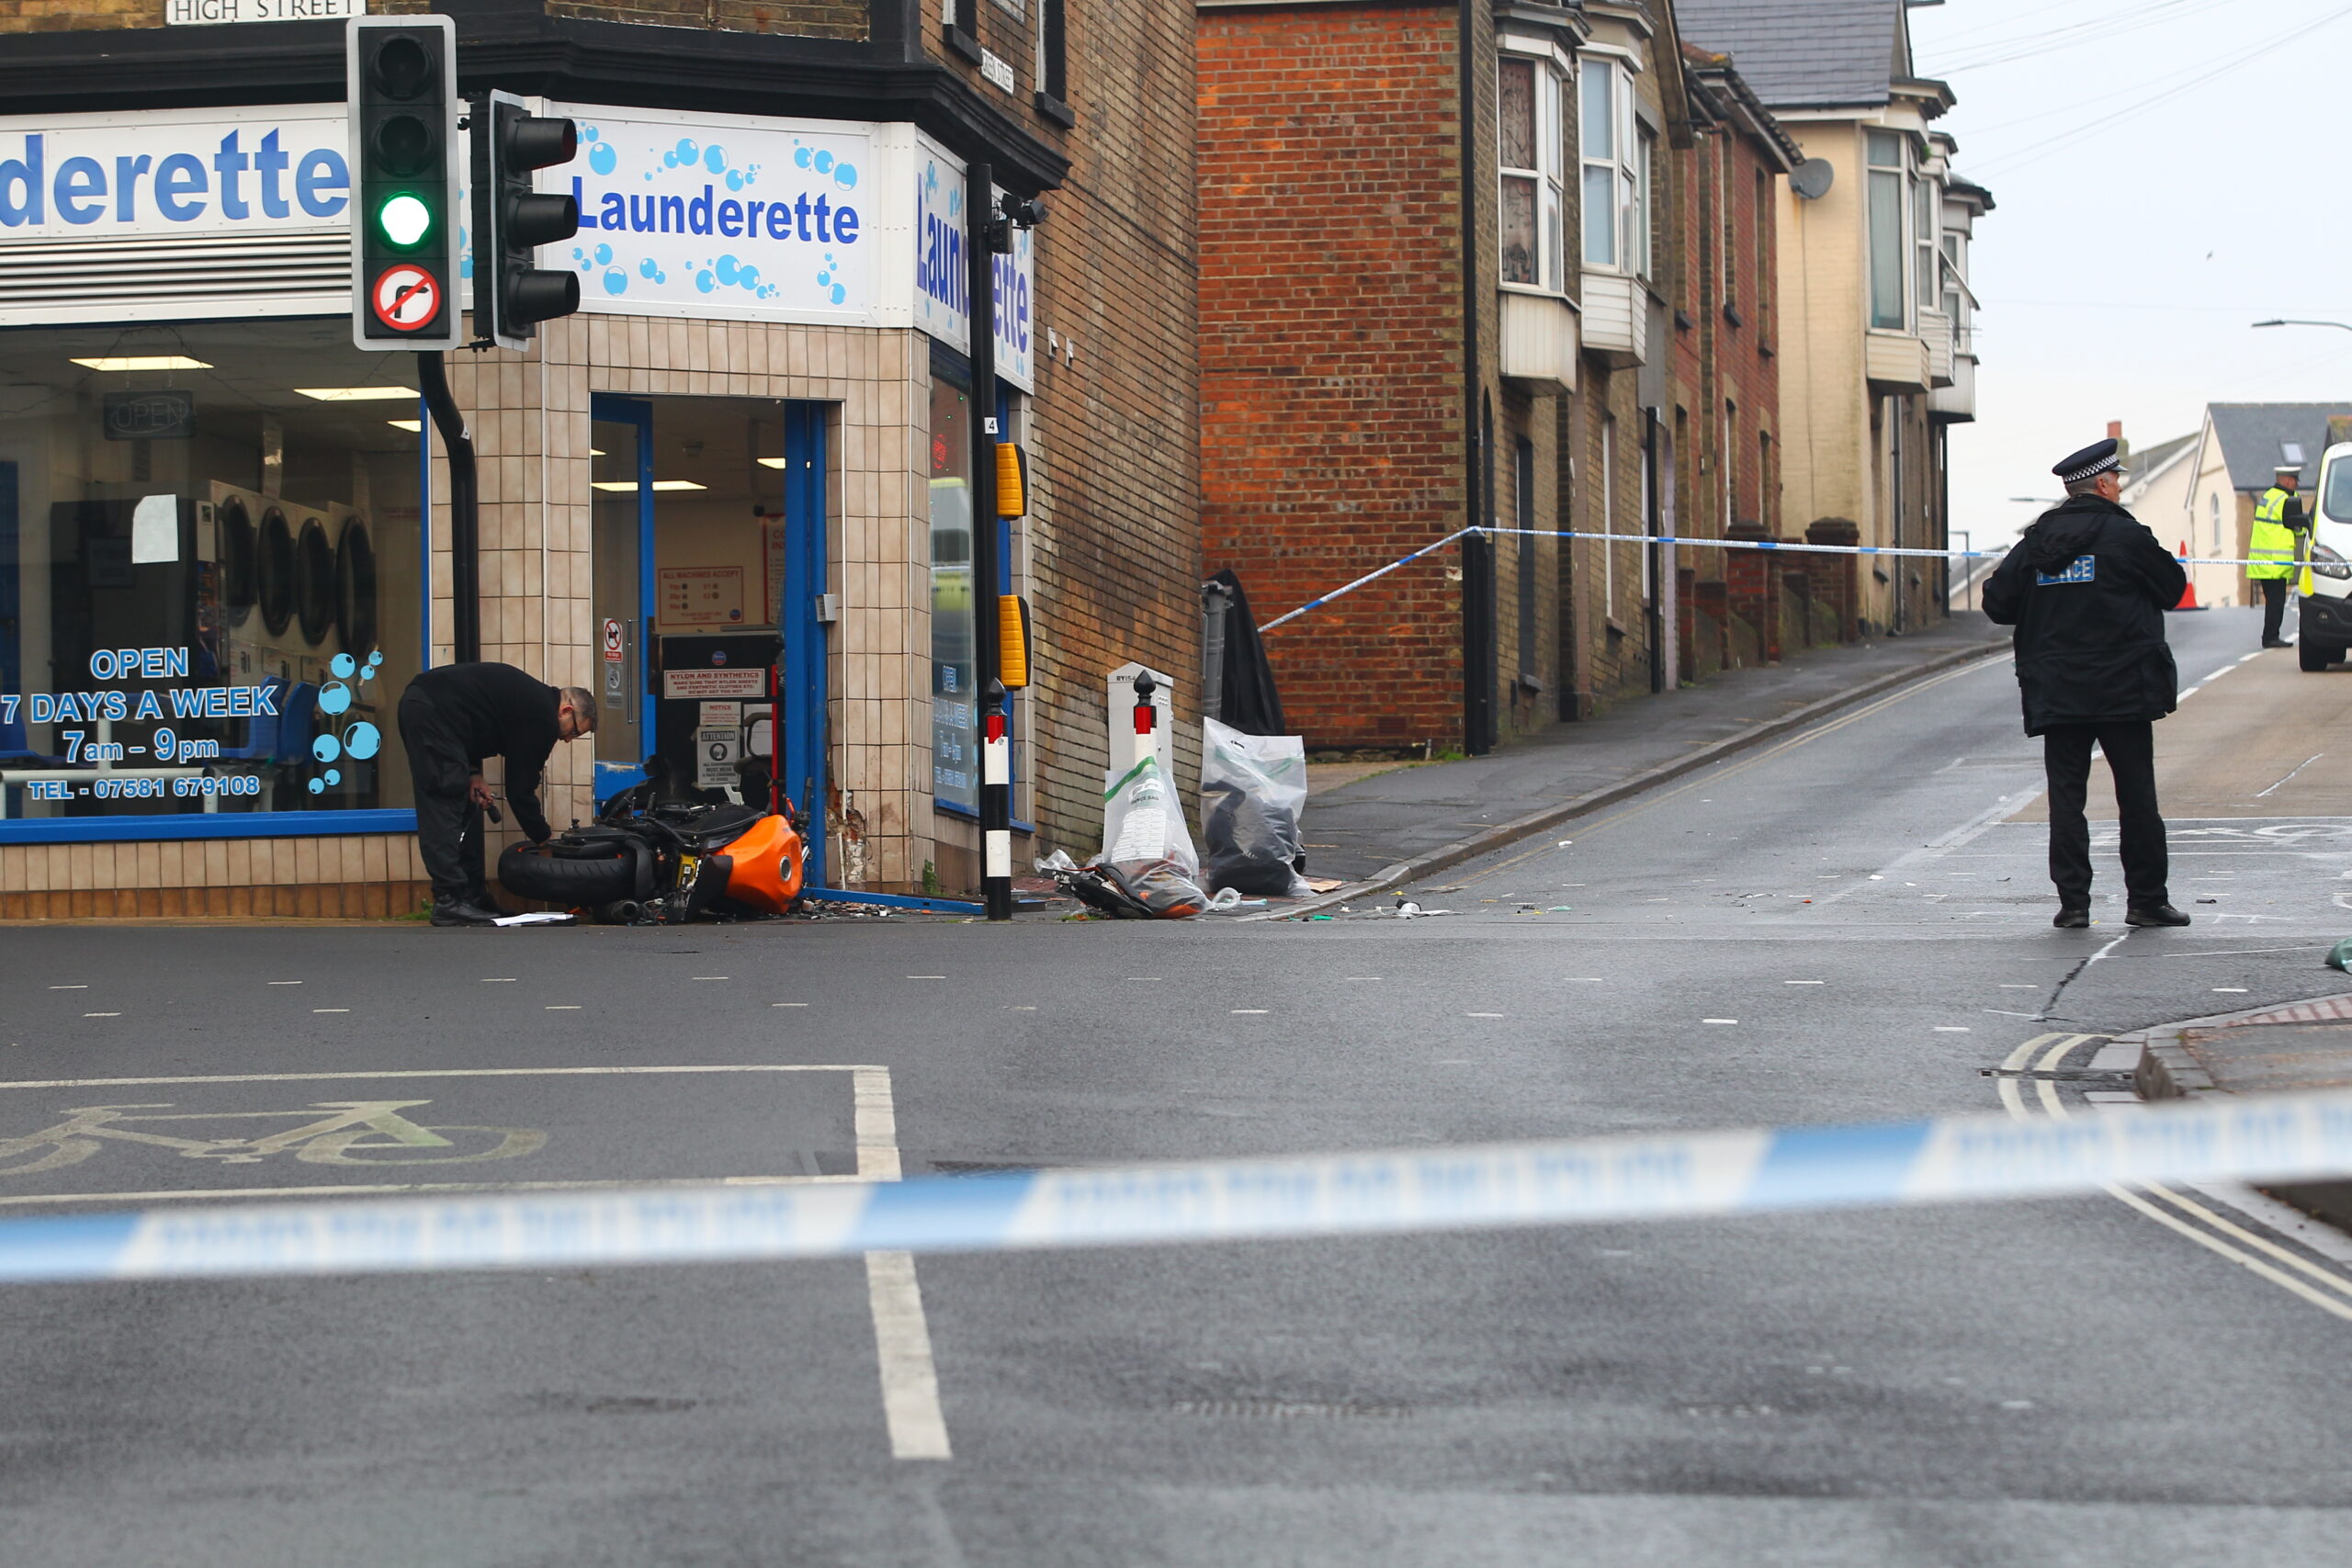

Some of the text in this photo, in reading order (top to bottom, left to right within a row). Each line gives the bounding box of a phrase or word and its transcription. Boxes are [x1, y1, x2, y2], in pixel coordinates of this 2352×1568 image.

[175, 0, 352, 21] HIGH STREET
[572, 175, 859, 245] Launderette
[989, 420, 995, 432] 4
[90, 647, 189, 680] OPEN
[1, 685, 278, 724] 7 DAYS A WEEK
[702, 731, 735, 740] ATTENTION
[28, 781, 75, 800] TEL
[95, 778, 165, 798] 07581
[173, 776, 260, 797] 679108
